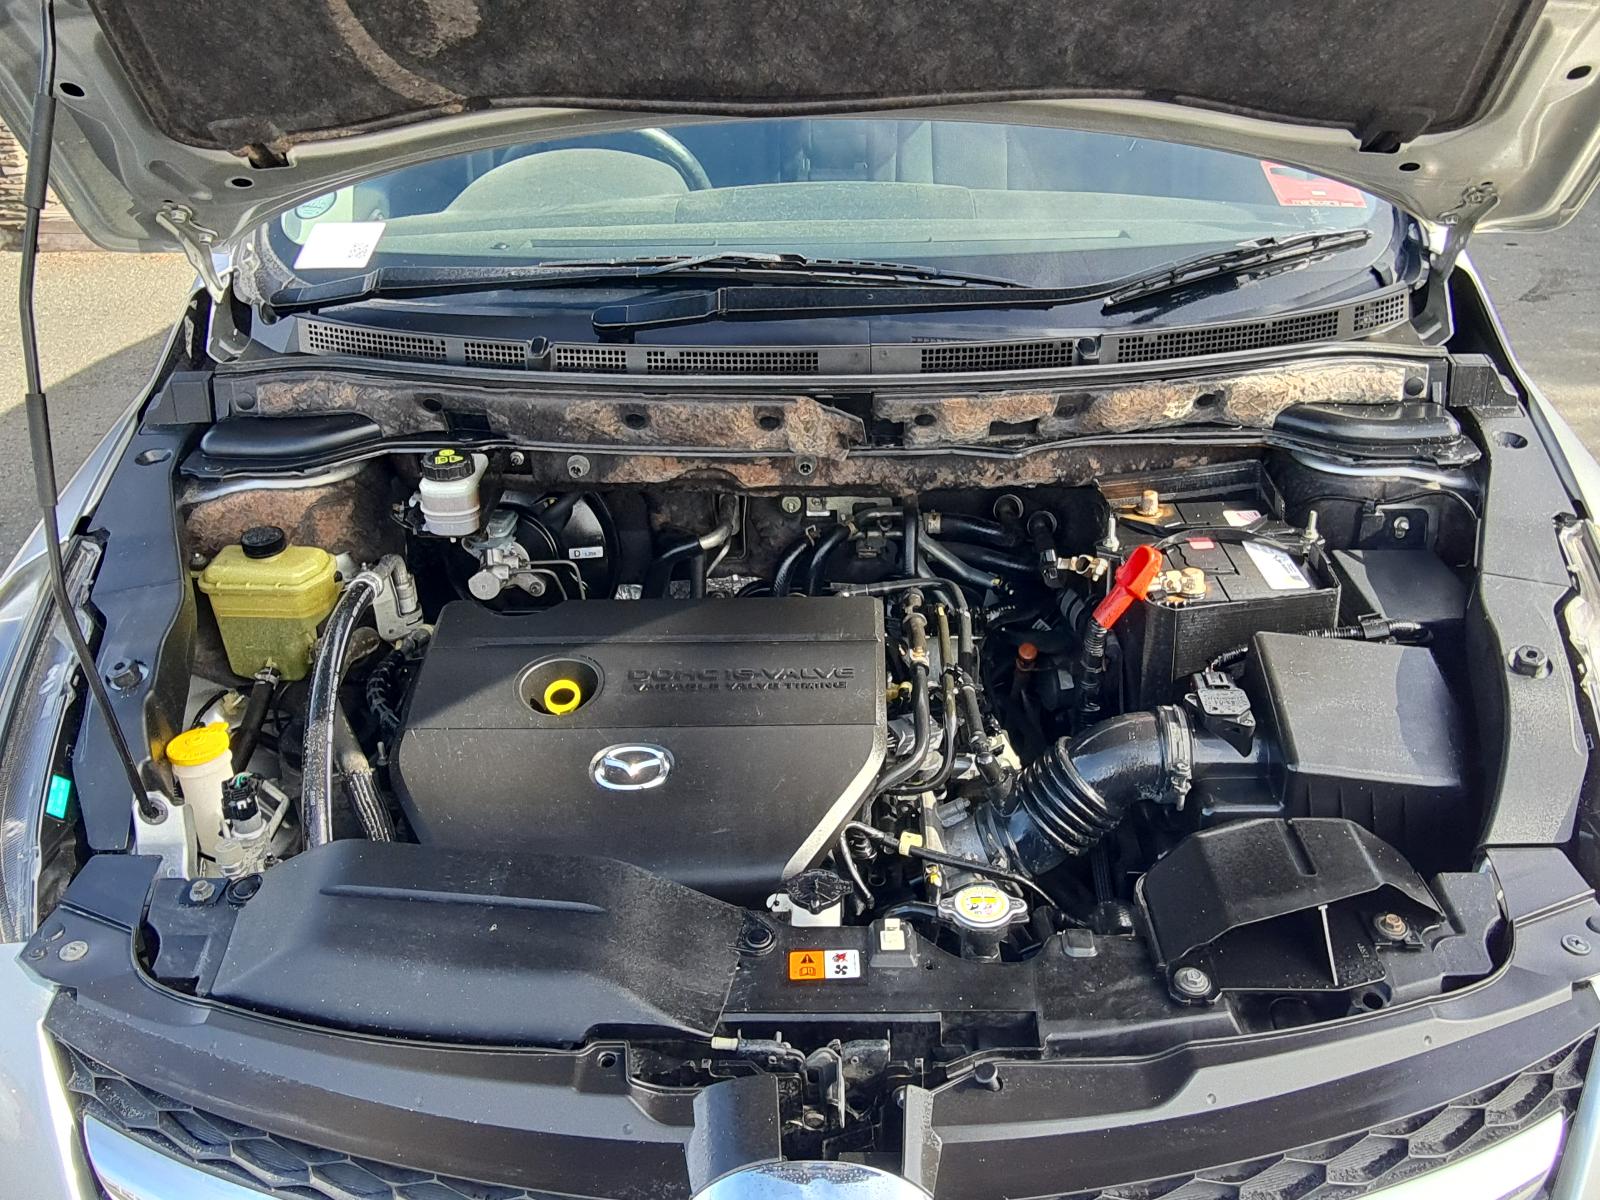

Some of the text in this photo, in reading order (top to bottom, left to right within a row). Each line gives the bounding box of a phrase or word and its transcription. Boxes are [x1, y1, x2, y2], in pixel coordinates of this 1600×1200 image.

[627, 666, 855, 682] DOHC 16-VALVE
[725, 681, 779, 690] VALVE
[784, 680, 848, 689] TIMING
